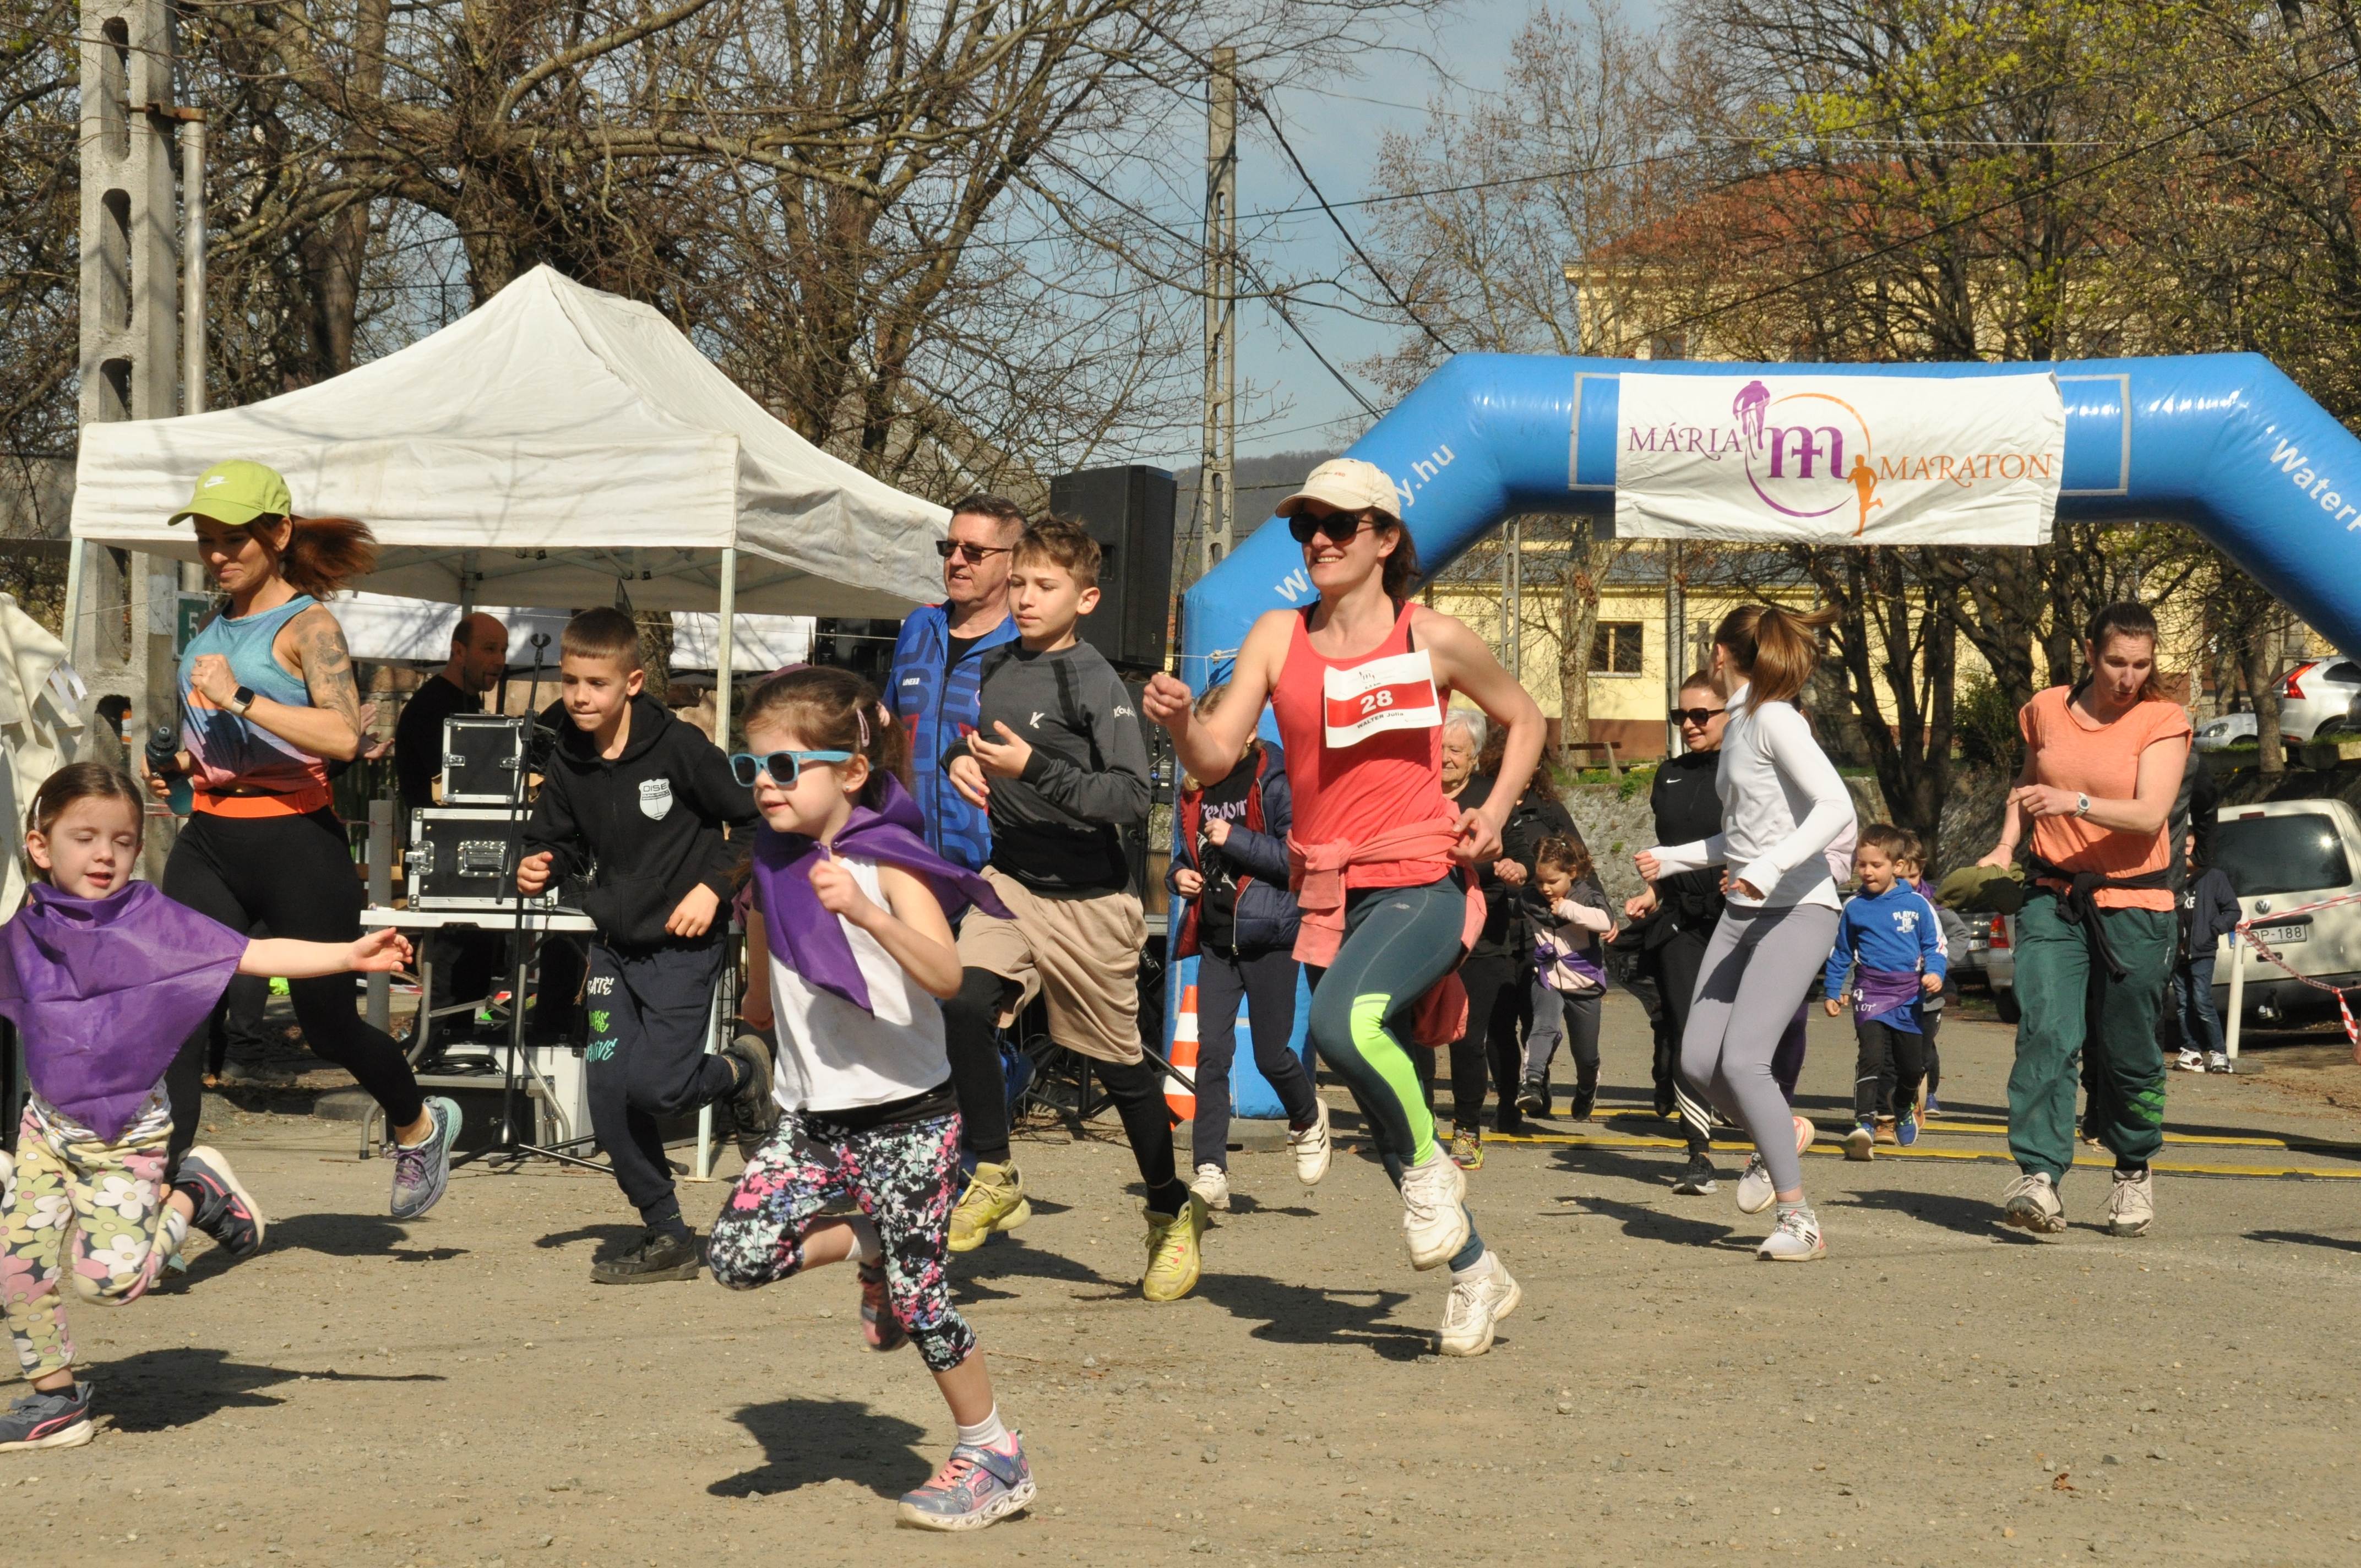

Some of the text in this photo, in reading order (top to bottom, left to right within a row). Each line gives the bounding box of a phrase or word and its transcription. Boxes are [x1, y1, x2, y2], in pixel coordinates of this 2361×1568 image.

[1628, 422, 1744, 461] MÁRIA
[1878, 454, 2052, 488] MARATON
[1360, 690, 1394, 715] 28
[1357, 714, 1385, 729] WALTER
[643, 782, 667, 792] DISE
